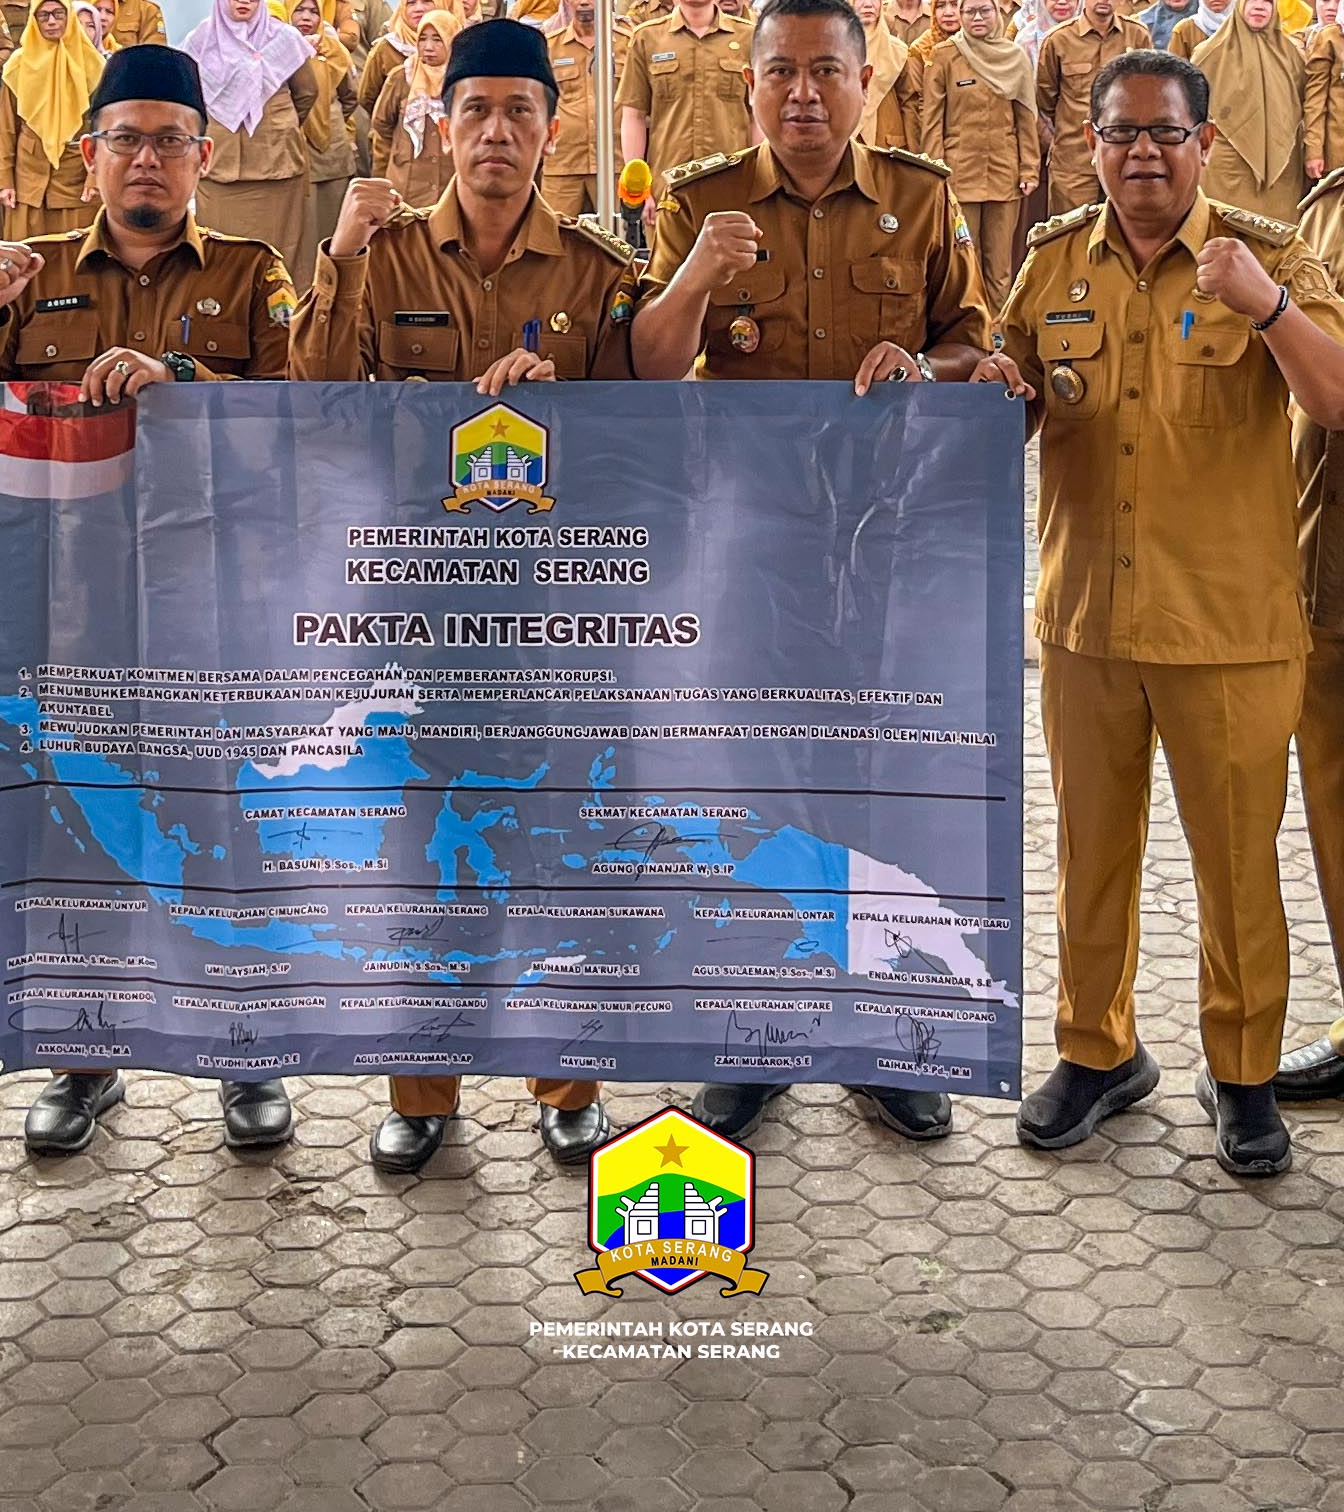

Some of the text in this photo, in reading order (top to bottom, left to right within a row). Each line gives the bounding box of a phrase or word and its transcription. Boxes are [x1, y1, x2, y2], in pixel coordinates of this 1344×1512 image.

[463, 481, 535, 494] KOTA SERANG
[347, 526, 648, 549] PEMERINTAH KOTA SERANG
[346, 559, 649, 585] KECAMATAN SERANG
[293, 612, 700, 647] PAKTA INTEGRITAS
[18, 666, 616, 683] 1. MEMPERKUAT KOMITMEN BERSAMA DALAM PENCEGAHAN DAN PEMBERANTASAN KORUPSI.
[38, 685, 199, 702] MENUMBUHKEMBANGKAN
[204, 688, 301, 702] KETERBUKAAN
[305, 688, 331, 700] DAN
[335, 688, 414, 701] KEJUJURAN
[418, 688, 460, 700] SERTA
[464, 688, 571, 701] MEMPERLANCAR
[574, 688, 671, 701] PELAKSANAAN
[673, 688, 718, 701] TUGAS
[722, 688, 757, 700] YANG
[761, 689, 855, 704] BERKUALITAS,
[858, 691, 911, 704] EFEKTIF
[915, 692, 944, 706] DAN
[39, 702, 113, 718] AKUNTABEL
[39, 720, 128, 737] MEWUJUDKAN
[132, 725, 212, 740] PEMERINTAH
[215, 726, 242, 740] DAN
[246, 725, 333, 739] MASYARAKAT
[338, 725, 373, 738] YANG
[377, 725, 418, 740] MAJU,
[420, 726, 481, 741] MANDIRI,
[484, 726, 628, 739] BERJANGGUNGJAWAB
[632, 727, 658, 738] DAN
[662, 725, 750, 739] BERMANFAAT
[753, 726, 807, 738] DENGAN
[810, 727, 879, 740] DILANDASI
[883, 729, 917, 742] OLEH
[921, 730, 996, 746] NILAI-NILAI
[40, 740, 81, 753] LUHUR
[85, 742, 134, 755] BUDAYA
[138, 743, 191, 759] BANGSA,
[196, 746, 222, 758] UUD
[226, 746, 256, 759] 1945
[260, 745, 287, 757] DAN
[291, 744, 364, 757] PANCASILA
[245, 806, 405, 820] CAMAT KECAMATAN SERANG
[580, 807, 748, 818] SEKMAT KECAMATAN SERANG
[262, 861, 275, 872] H.
[592, 864, 633, 875] AGUNG
[16, 899, 52, 912] KEPALA
[54, 899, 112, 911] KELURAHAN
[169, 905, 328, 918] KEPALA KELURAHAN CIMUNCANG
[346, 905, 488, 916] KEPALA KELURAHAN SERANG
[508, 906, 664, 917] KEPALA KELURAHAN SUKAWANA
[695, 909, 835, 921] KEPALA KELURAHAN LONTAR
[852, 912, 1010, 930] KEPALA KELURAHAN KOTA BARU
[7, 956, 34, 970] NANA
[206, 964, 224, 975] UMI
[533, 962, 581, 974] MUHAMAD
[693, 967, 779, 978] AGUS SULAEMAN,
[868, 970, 975, 988] ENDANG KUSNANDAR,
[8, 992, 44, 1004] KEPALA
[46, 989, 104, 1002] KELURAHAN
[173, 997, 326, 1011] KEPALA KELURAHAN KAGUNGAN
[341, 998, 488, 1009] KEPALA KELURAHAN KALIGANDU
[506, 999, 671, 1012] KEPALA KELURAHAN SUMUR PECUNG
[695, 1000, 831, 1011] KEPALA KELURAHAN CIPARE
[855, 1003, 995, 1022] KEPALA KELURAHAN LOPANG
[355, 1054, 380, 1065] AGUS
[715, 1056, 739, 1066] ZAKI
